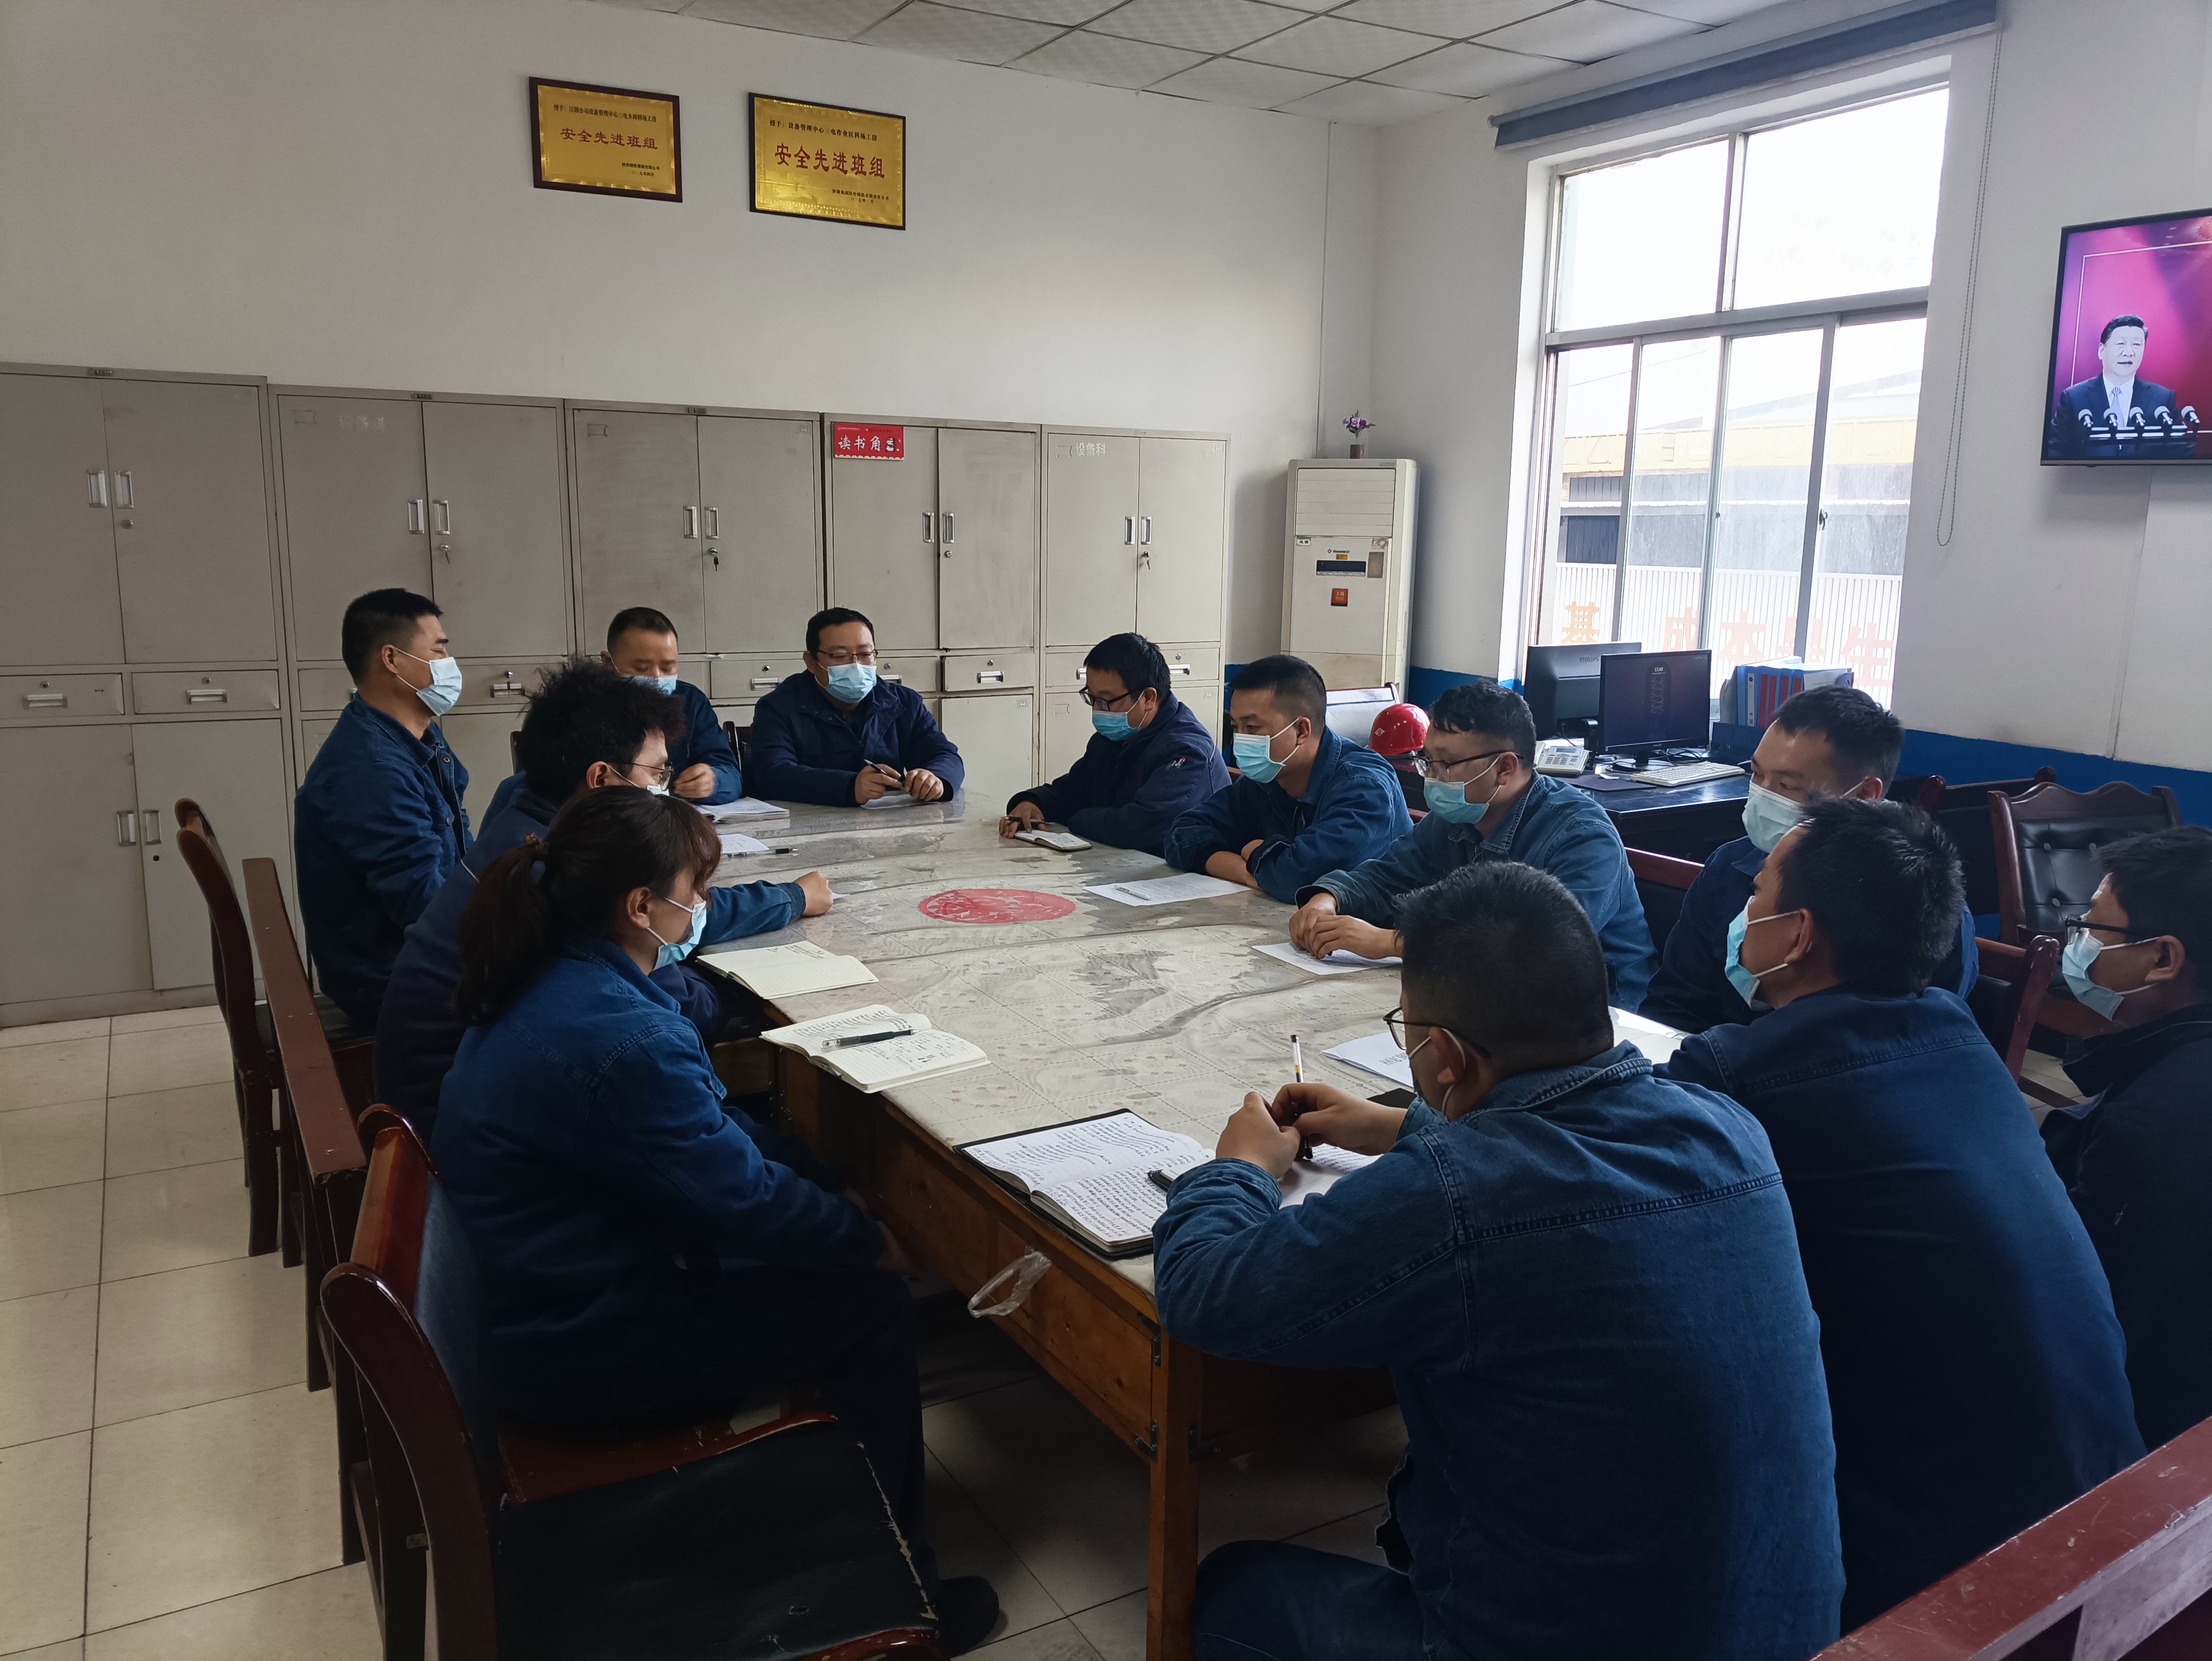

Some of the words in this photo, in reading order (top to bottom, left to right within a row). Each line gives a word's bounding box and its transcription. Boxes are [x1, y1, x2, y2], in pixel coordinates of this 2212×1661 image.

[560, 128, 658, 150] 安全先进班组
[769, 119, 878, 142] 授予：设备管理中心电作业区料场工段
[774, 143, 885, 179] 安全先进班组
[838, 434, 881, 452] 读书角
[1075, 443, 1106, 456] 设备科
